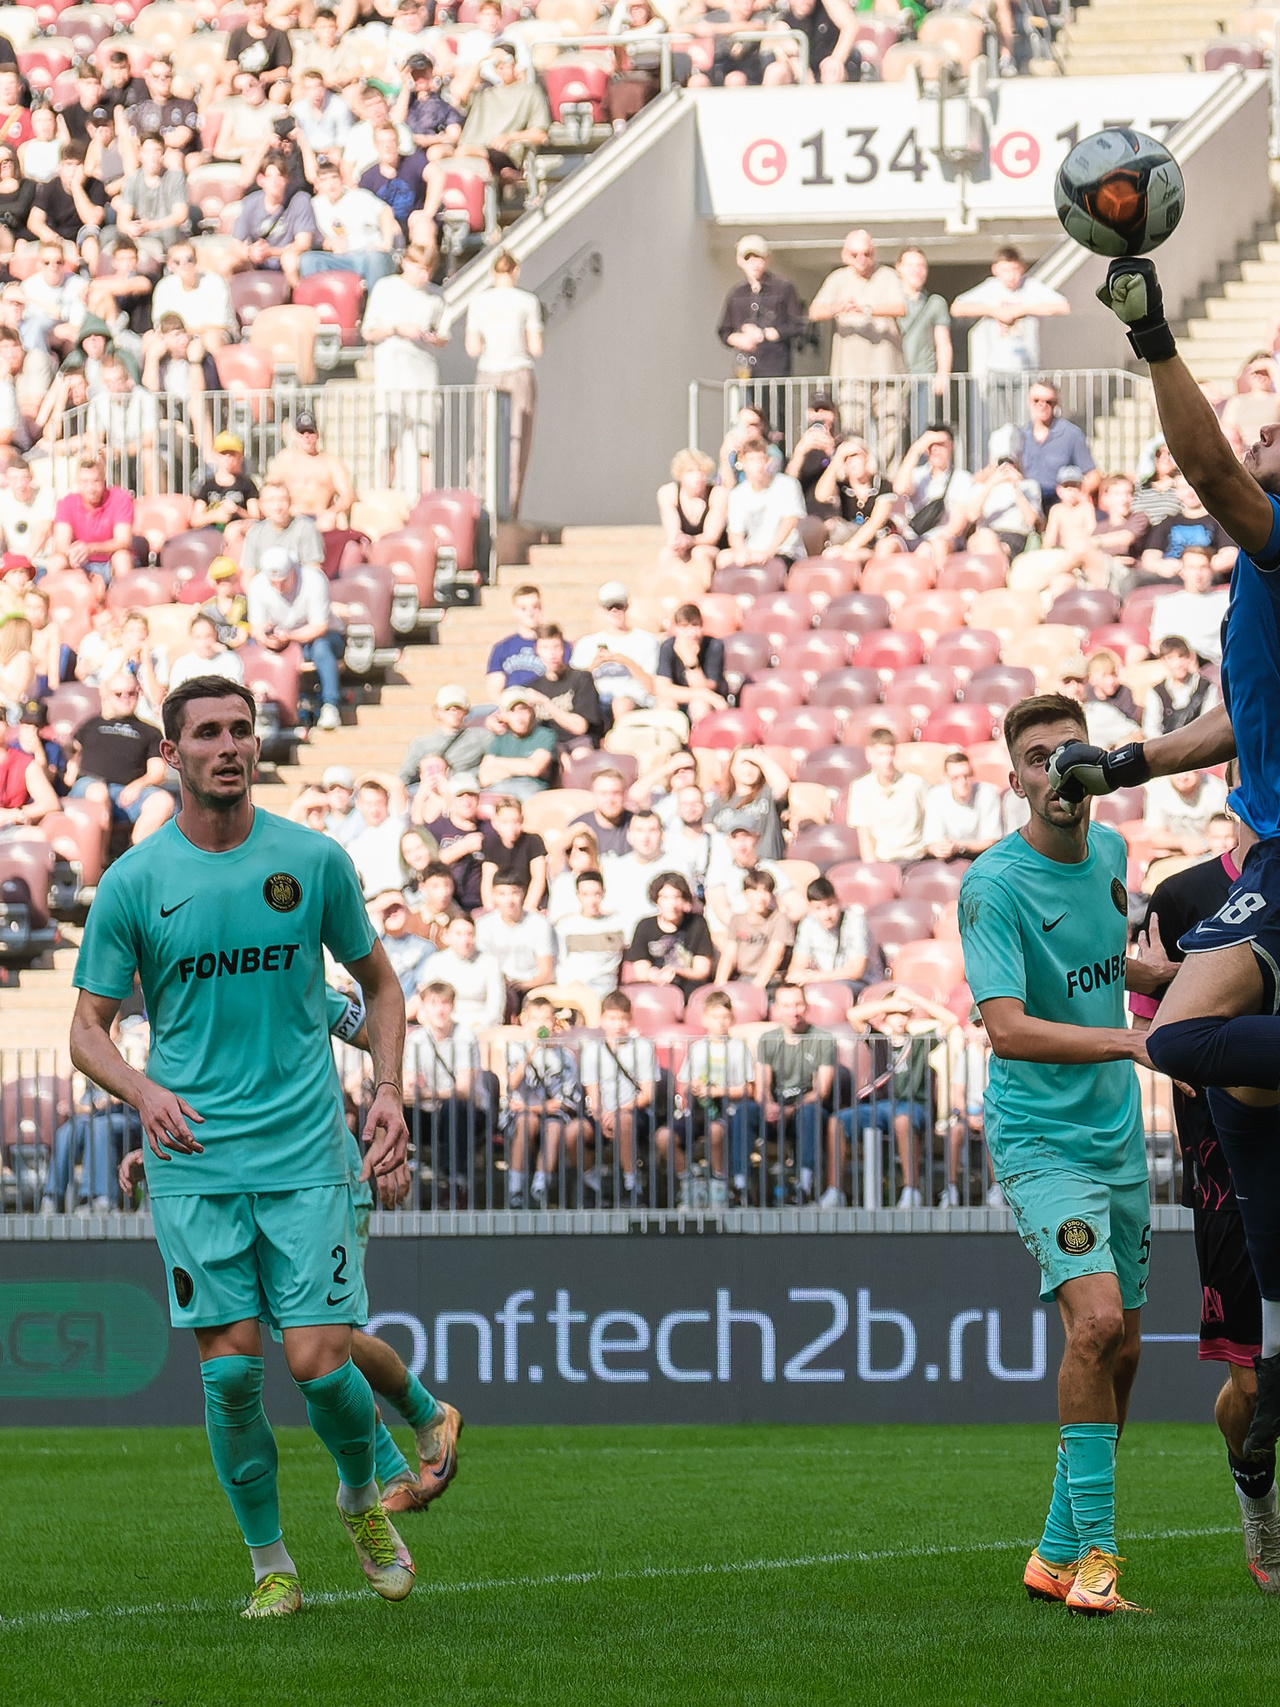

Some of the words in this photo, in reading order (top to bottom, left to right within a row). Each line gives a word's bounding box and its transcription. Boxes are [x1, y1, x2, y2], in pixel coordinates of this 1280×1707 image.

[800, 127, 929, 186] 134
[178, 943, 300, 984] FONBET
[1066, 949, 1127, 999] FONBE
[331, 1244, 349, 1286] 2
[2, 1310, 105, 1372] СЯ
[365, 1287, 1047, 1383] onf.tech2b.ru
